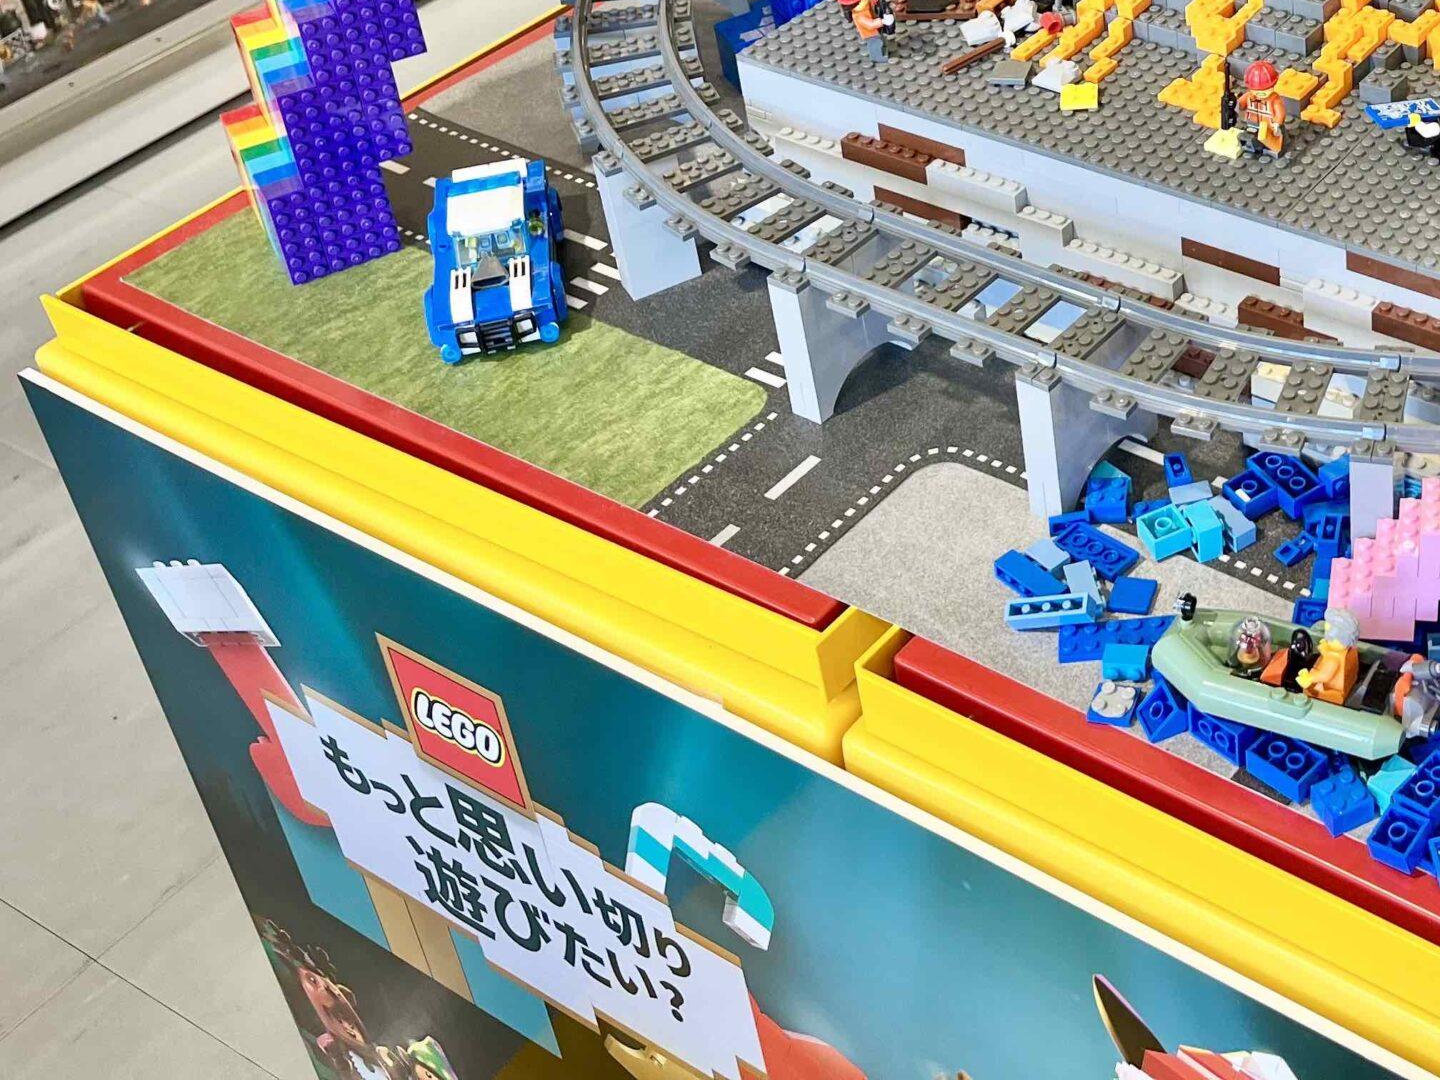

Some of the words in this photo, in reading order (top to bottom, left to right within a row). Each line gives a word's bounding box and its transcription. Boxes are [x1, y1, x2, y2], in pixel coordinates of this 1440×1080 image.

[414, 690, 502, 764] LEGO
[320, 734, 691, 978] もっと思い切り
